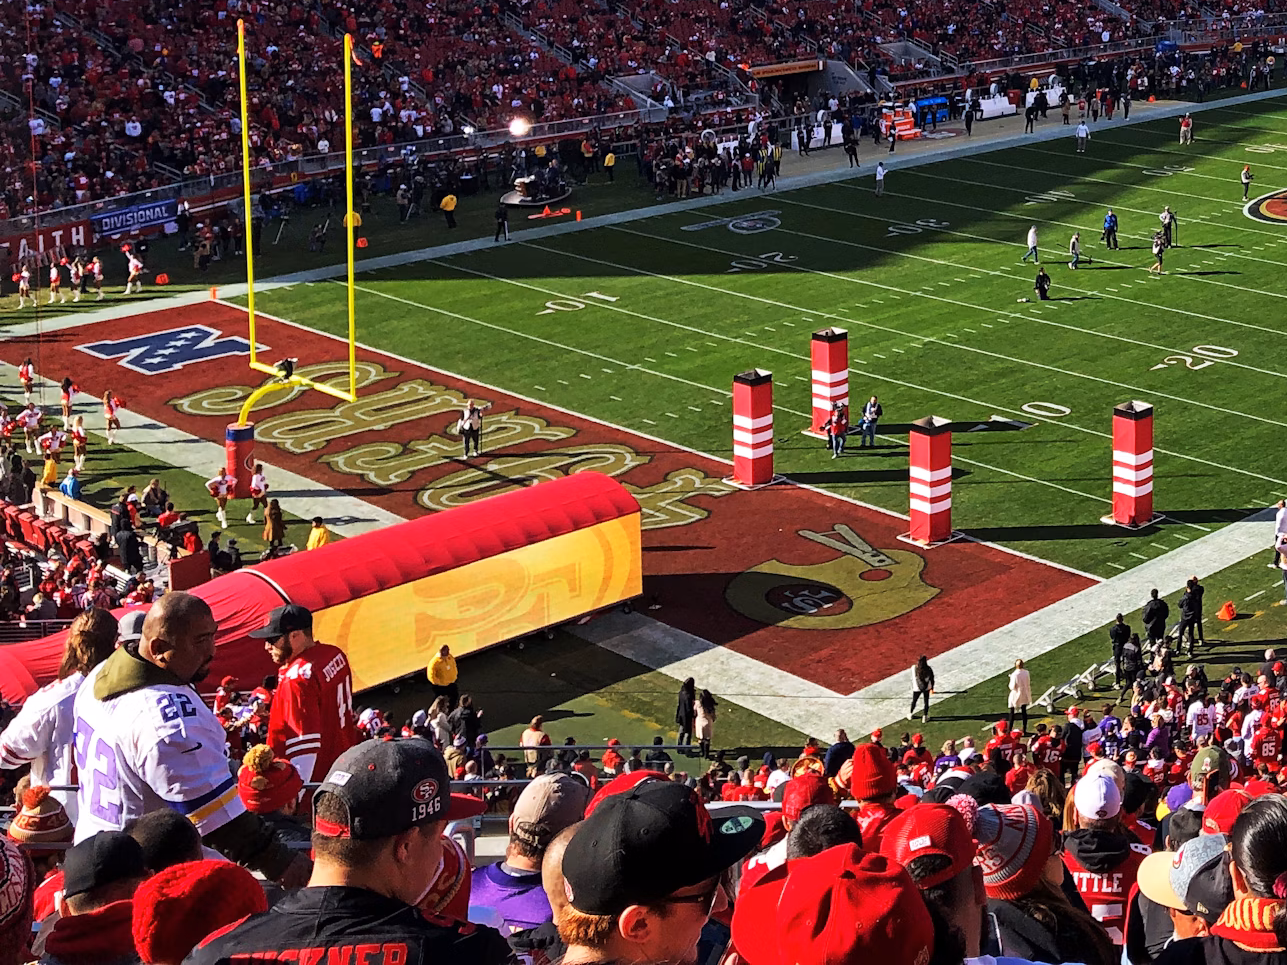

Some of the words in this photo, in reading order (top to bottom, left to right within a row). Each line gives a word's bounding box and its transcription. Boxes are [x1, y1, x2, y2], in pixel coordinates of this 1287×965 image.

[101, 205, 169, 232] DIVISIONAL
[1165, 344, 1239, 370] 20
[156, 693, 198, 723] 22
[1196, 713, 1209, 726] 85
[1042, 748, 1060, 763] 16
[1261, 742, 1276, 757] 85
[411, 801, 442, 823] 1946
[1071, 871, 1124, 893] ITTLE
